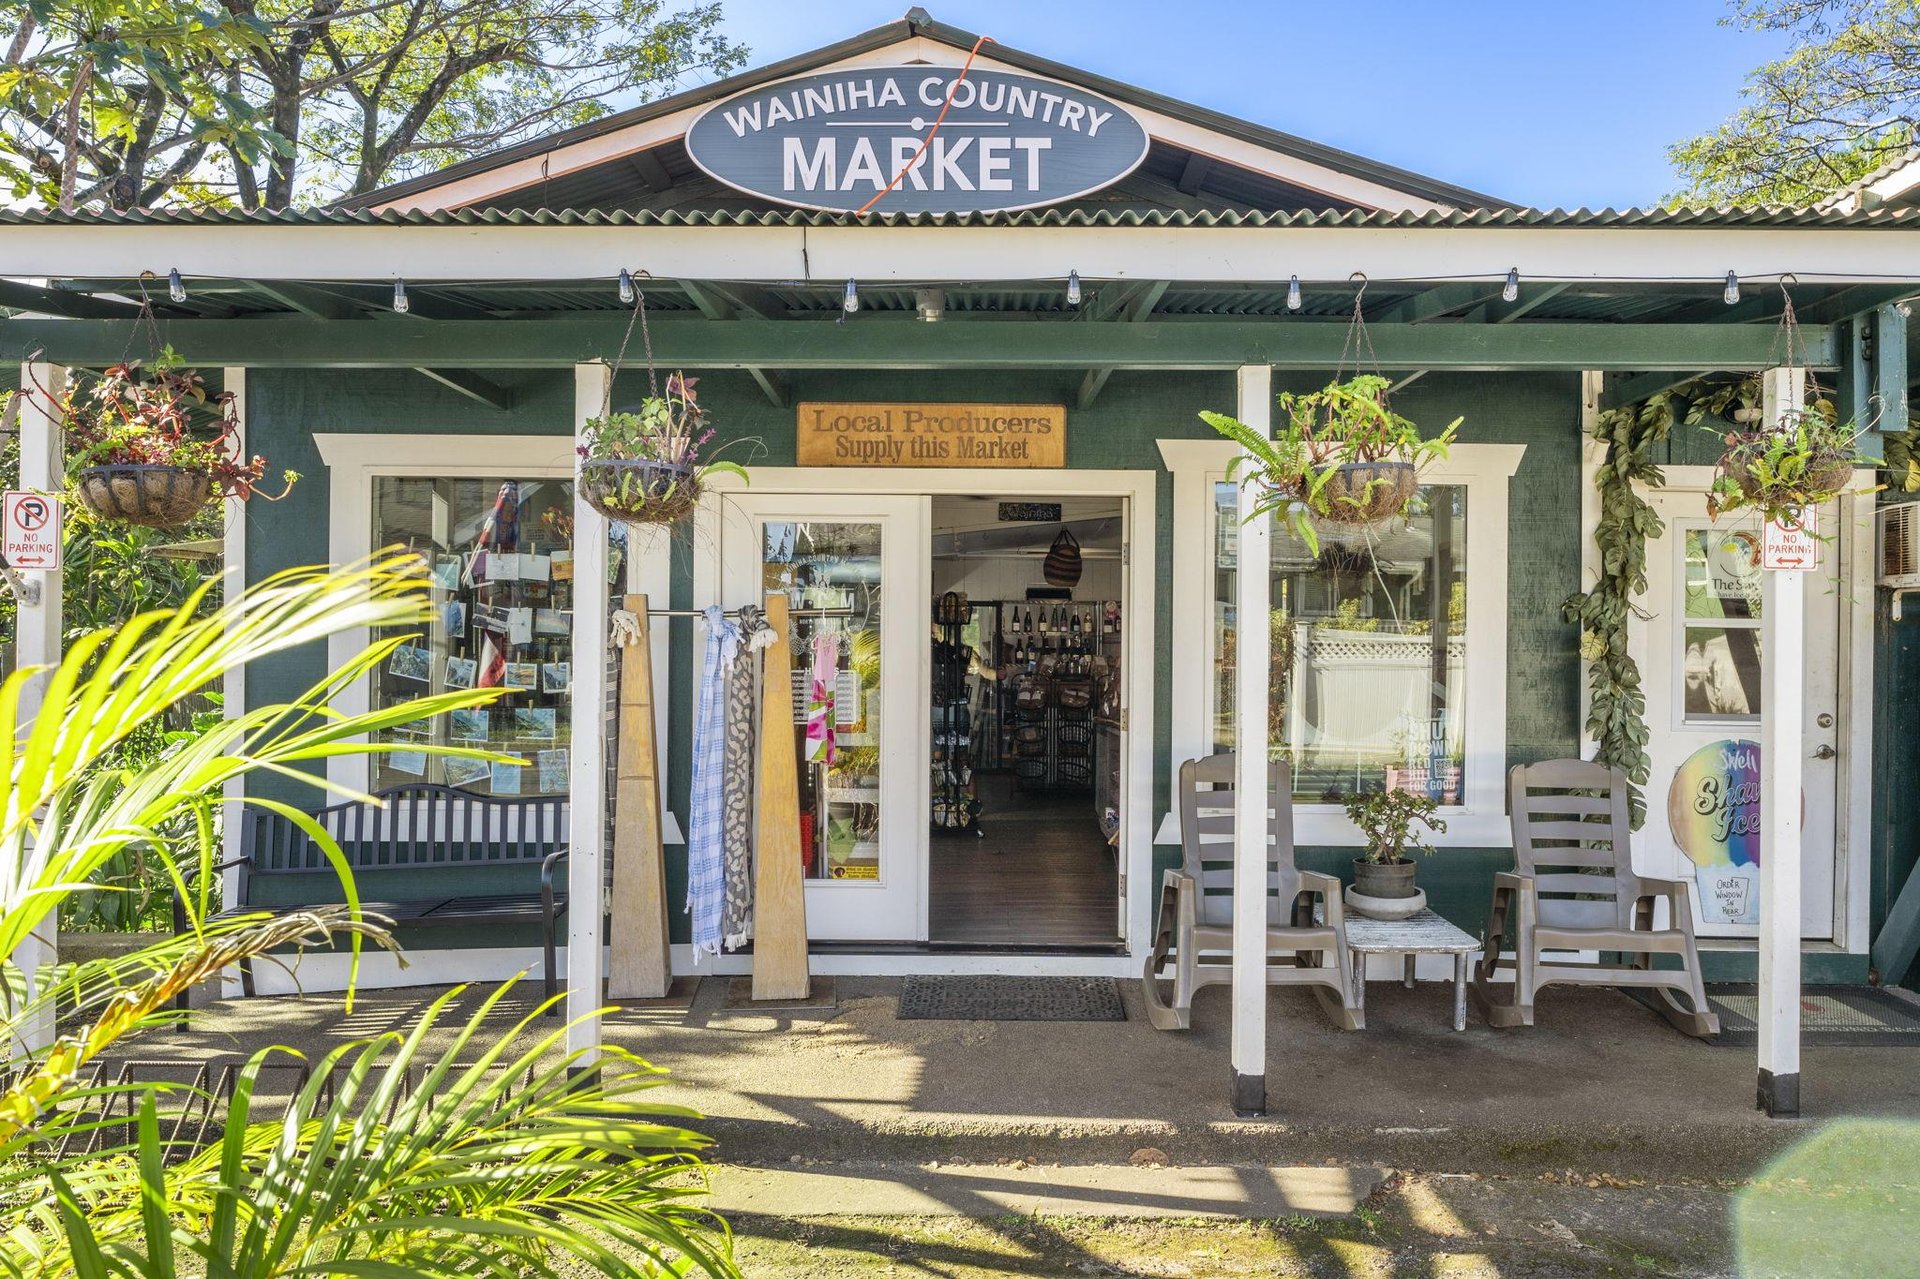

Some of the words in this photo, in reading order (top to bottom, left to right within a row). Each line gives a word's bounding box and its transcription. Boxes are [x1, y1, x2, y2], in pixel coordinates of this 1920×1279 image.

[722, 77, 908, 138] WAINIHA
[918, 77, 1115, 138] COUNTRY
[783, 136, 1052, 192] MARKET
[812, 409, 892, 433] Local
[902, 409, 1052, 434] Producers
[835, 434, 904, 463] Supply
[910, 435, 949, 459] this
[956, 435, 1029, 460] Market
[24, 533, 38, 542] NO
[1783, 534, 1797, 544] NO
[9, 543, 53, 553] PARKING
[1711, 578, 1734, 590] The
[1409, 757, 1431, 769] RED
[1409, 781, 1428, 791] FOR
[1430, 779, 1456, 790] GOOD
[1711, 806, 1760, 842] Ice
[1716, 879, 1740, 889] ORDER
[1715, 890, 1743, 899] WINDOW
